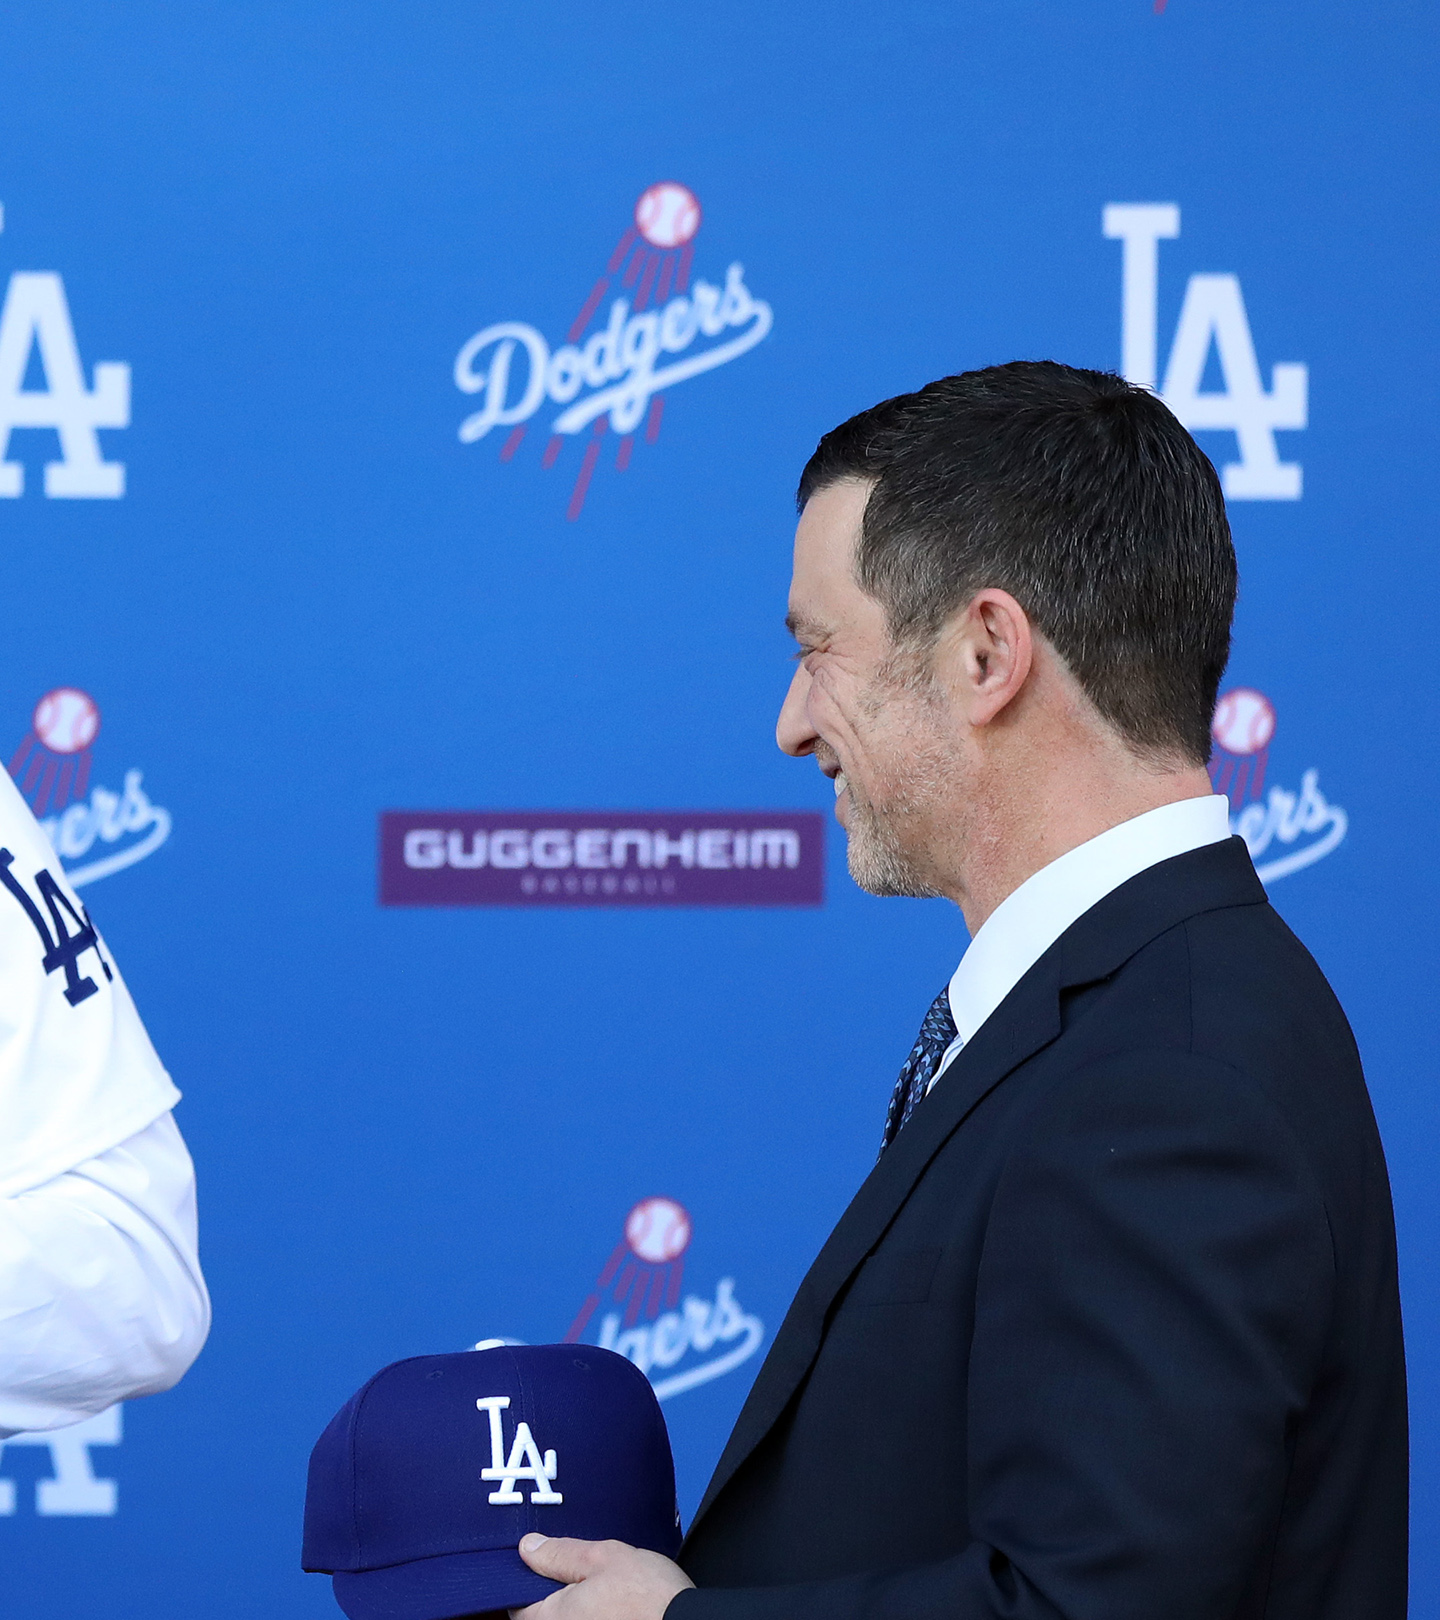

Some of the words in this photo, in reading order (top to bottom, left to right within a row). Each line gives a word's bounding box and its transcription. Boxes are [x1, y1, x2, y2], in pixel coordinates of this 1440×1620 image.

[454, 262, 773, 444] Dodgers
[1102, 202, 1309, 501] LA
[403, 828, 801, 870] GUGGENHEIM
[476, 1396, 563, 1505] LA
